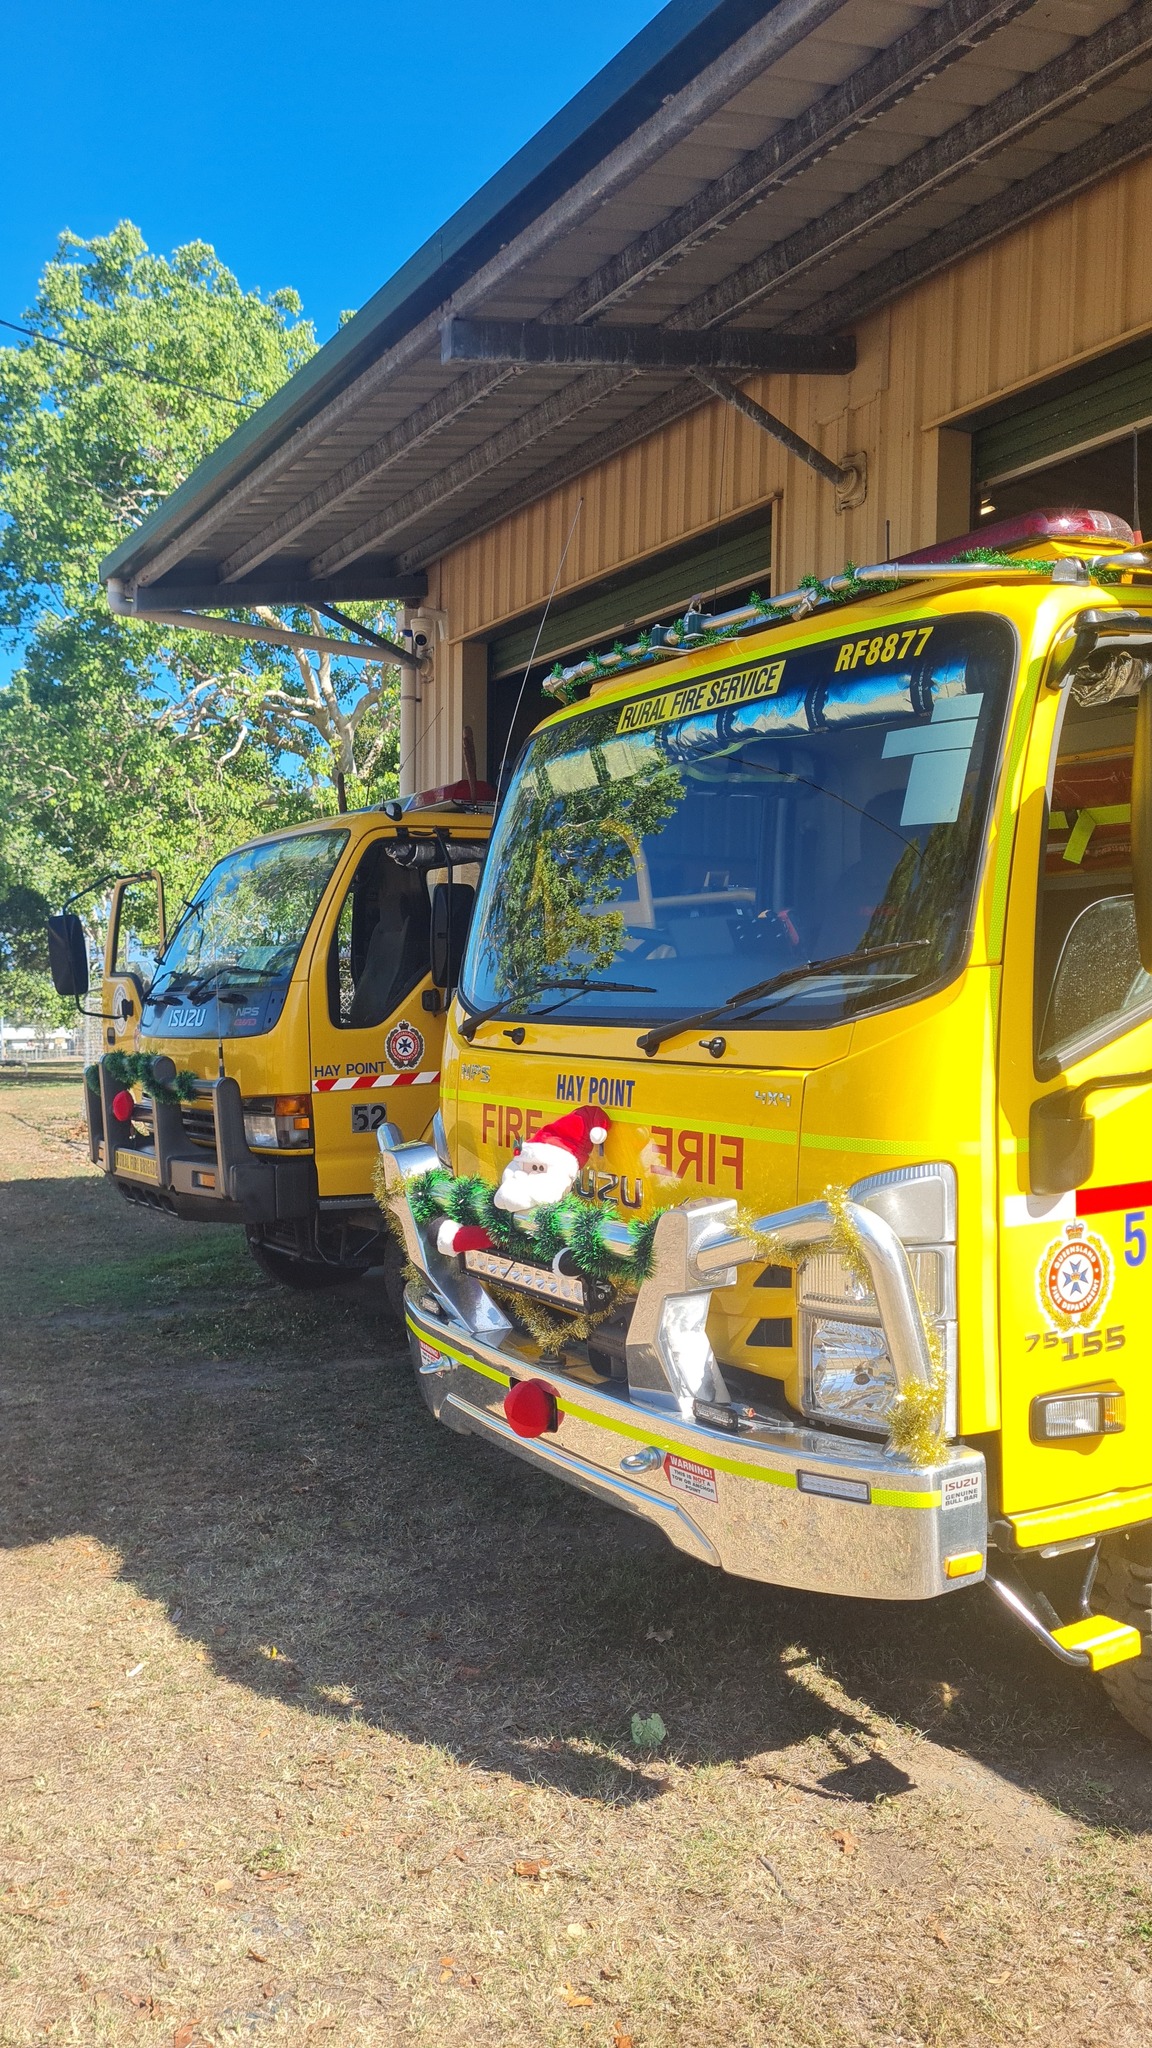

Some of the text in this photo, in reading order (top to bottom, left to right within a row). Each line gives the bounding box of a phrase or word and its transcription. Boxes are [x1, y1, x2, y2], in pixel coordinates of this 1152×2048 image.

[834, 626, 934, 673] RF8877
[621, 698, 666, 730] RURAL
[670, 685, 707, 718] FIRE
[706, 664, 779, 706] SERVICE
[168, 1008, 207, 1027] ISUZU
[236, 1007, 259, 1017] NPS
[314, 1061, 386, 1077] HAY POINT
[461, 1063, 490, 1083] NPS
[557, 1074, 636, 1108] HAY POINT
[353, 1105, 386, 1131] 52
[482, 1103, 542, 1148] FIRE
[575, 1169, 643, 1210] UZU
[1124, 1211, 1147, 1267] 5
[1054, 1245, 1097, 1270] QUEENSLAND
[1051, 1278, 1100, 1312] FIRE DEPARTMENT
[1025, 1325, 1126, 1362] 75 155
[670, 1456, 713, 1480] WARNING!
[674, 1470, 686, 1478] THIS
[693, 1476, 705, 1485] NOT
[672, 1474, 683, 1482] TOW
[693, 1483, 714, 1494] ANCHOR
[686, 1485, 701, 1494] POINT
[945, 1477, 978, 1491] ISUZU
[945, 1488, 978, 1501] GENUINE
[964, 1493, 978, 1502] BAR
